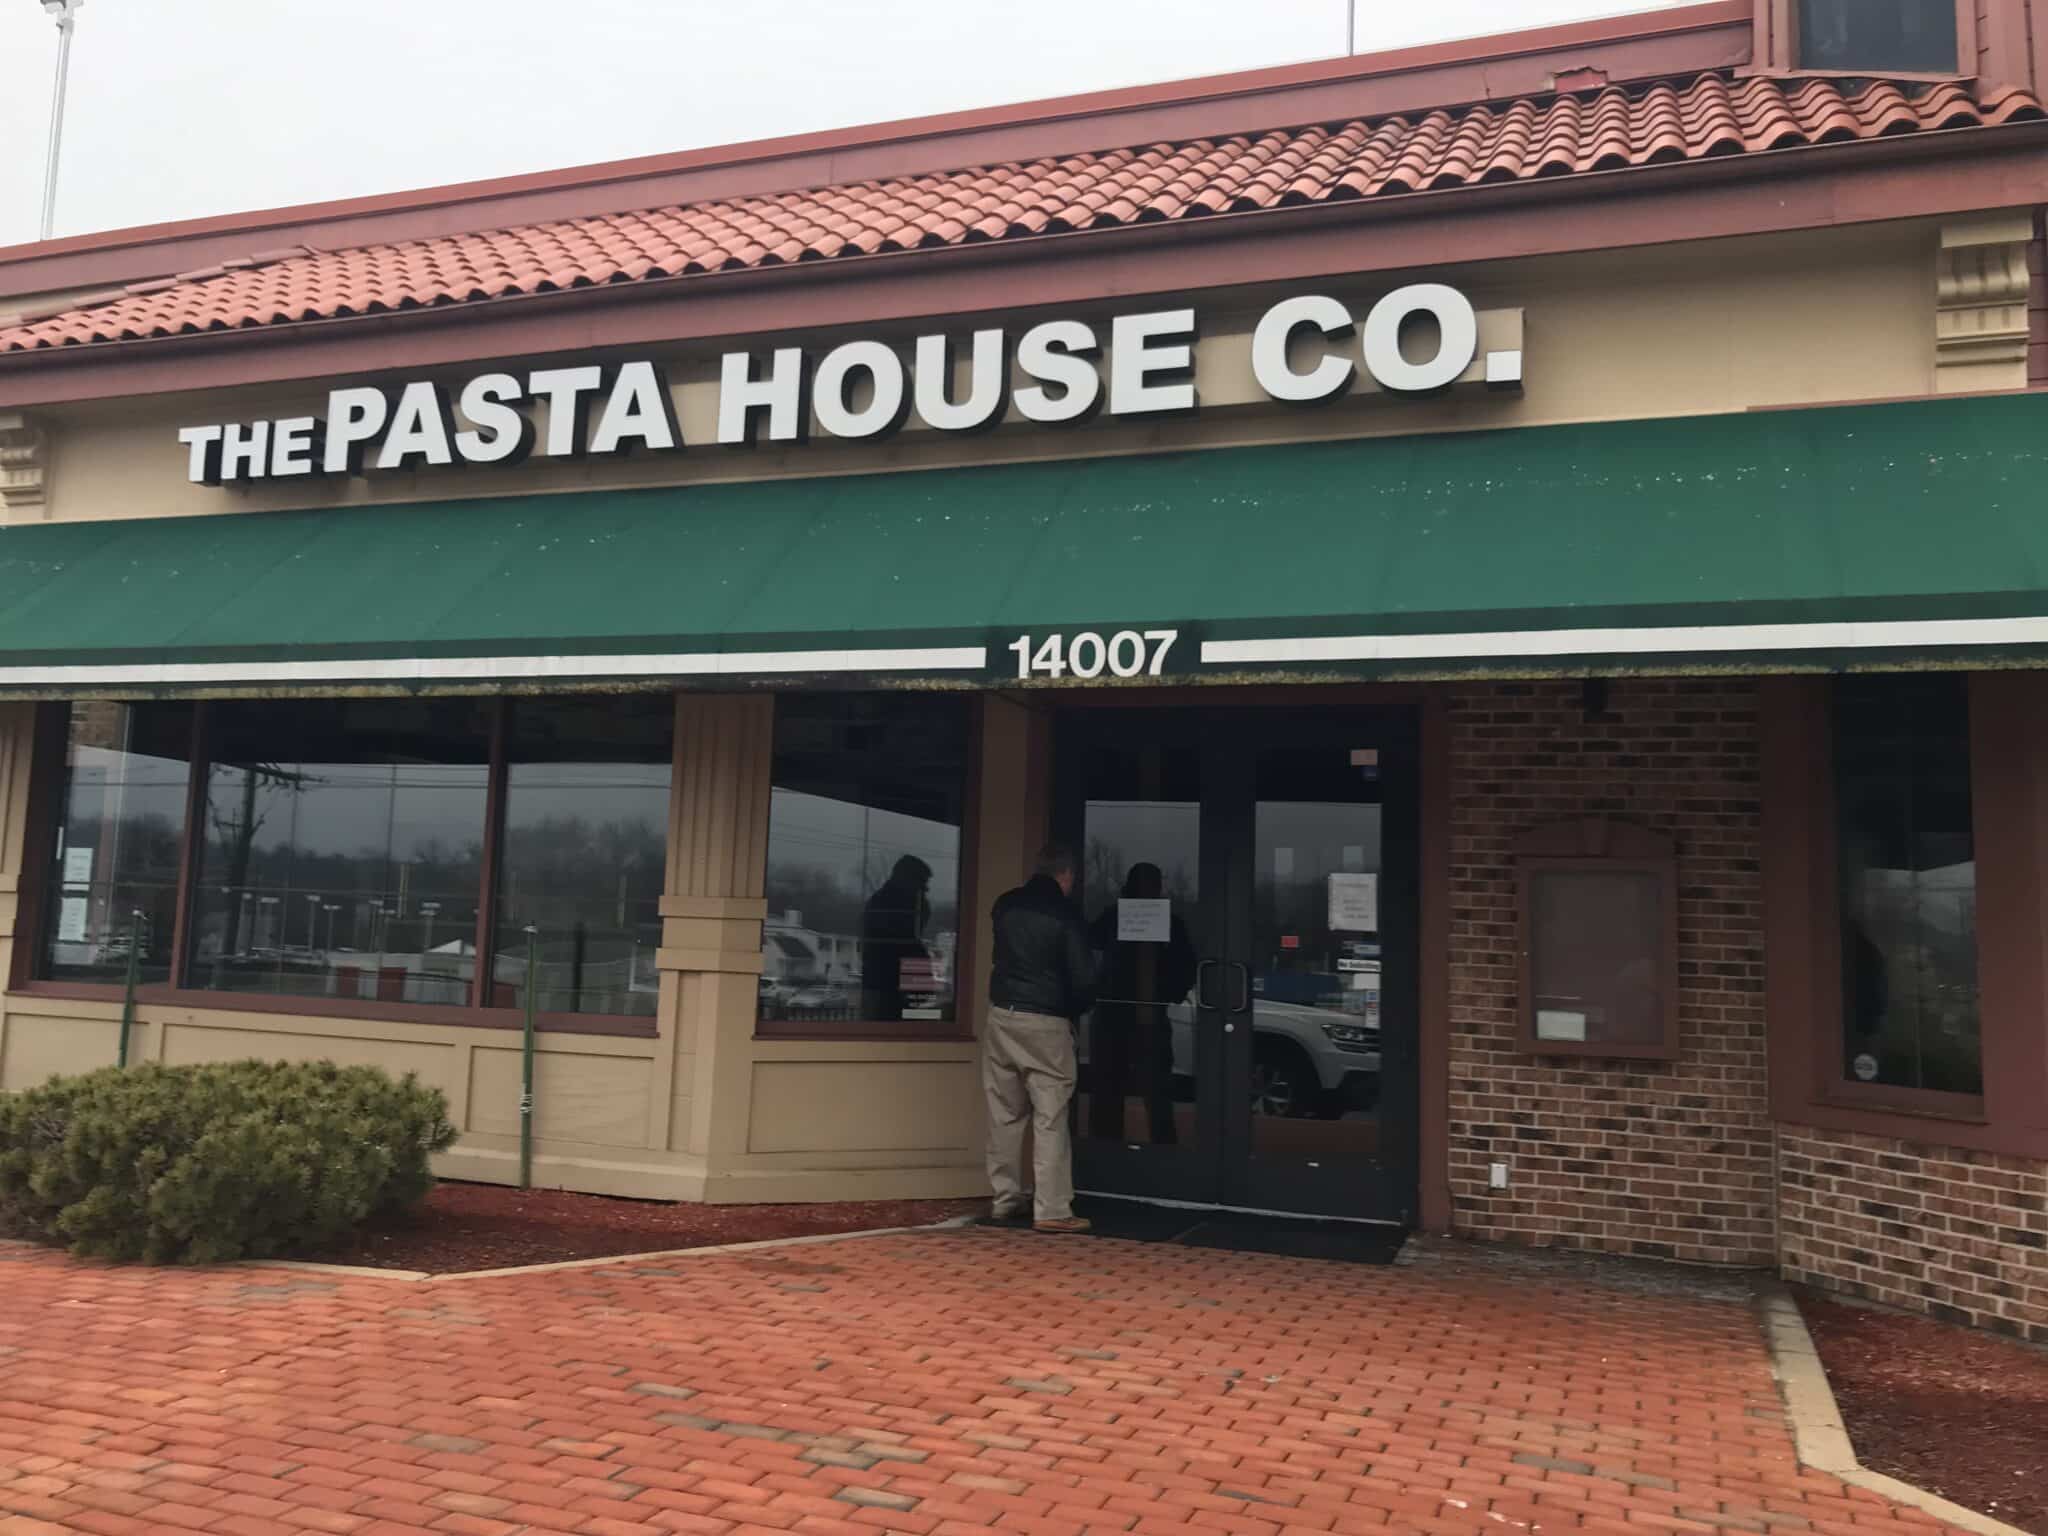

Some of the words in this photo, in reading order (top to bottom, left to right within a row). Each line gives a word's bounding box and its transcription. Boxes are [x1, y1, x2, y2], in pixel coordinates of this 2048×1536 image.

[178, 416, 315, 482] THE
[323, 361, 675, 472] PASTA
[717, 308, 1195, 444] HOUSE
[1252, 283, 1521, 401] CO.
[1008, 629, 1178, 679] 14007
